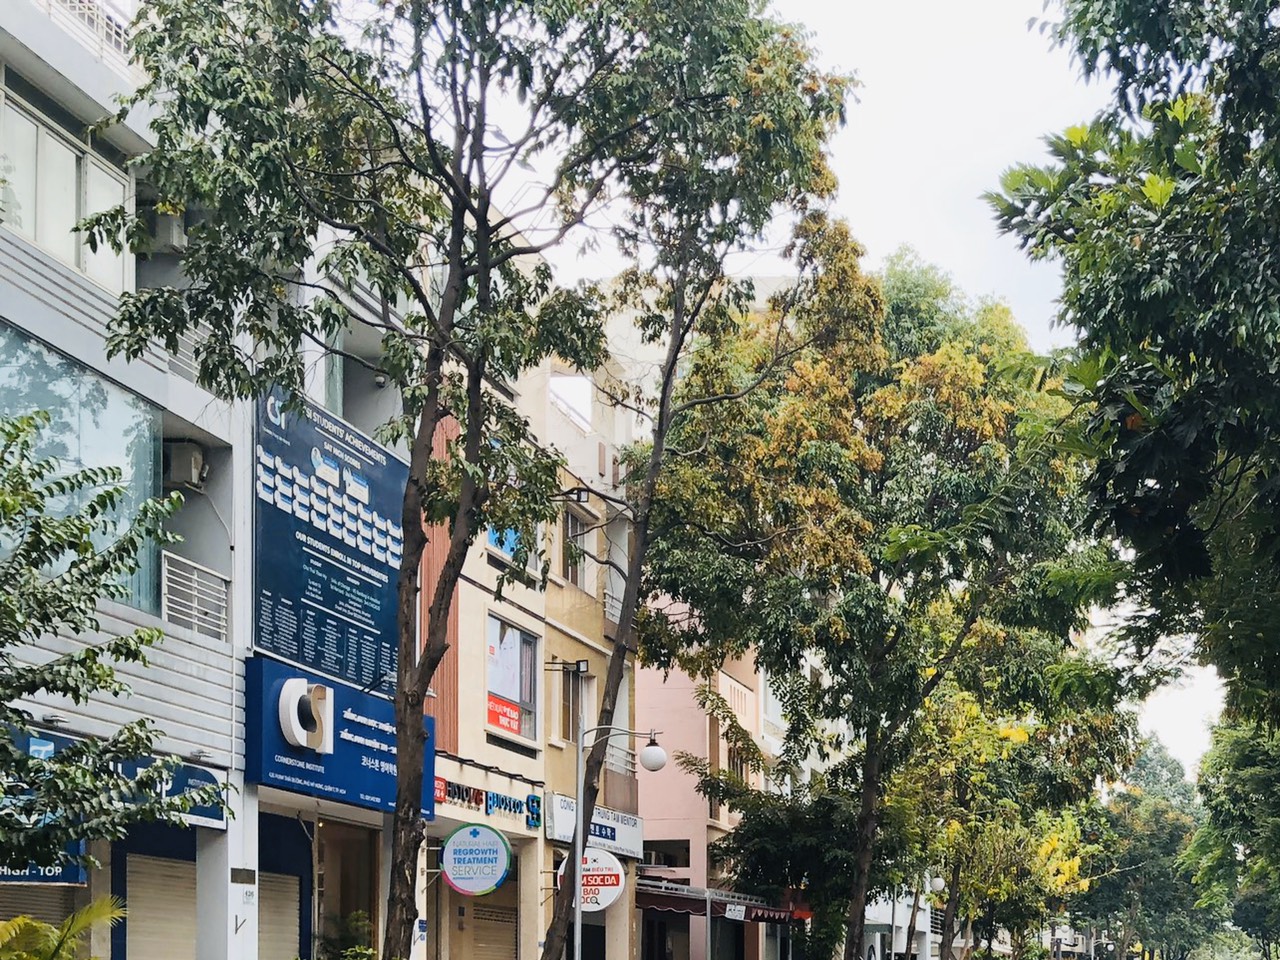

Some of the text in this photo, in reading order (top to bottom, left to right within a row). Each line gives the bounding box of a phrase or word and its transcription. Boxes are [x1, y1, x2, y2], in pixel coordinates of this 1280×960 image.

[345, 429, 387, 466] ACHIEVEMENTS
[453, 848, 498, 856] REGROWTH
[453, 857, 498, 865] TREATMENT
[37, 865, 62, 877] TOP
[451, 865, 497, 876] SERVICE
[604, 876, 617, 885] DA
